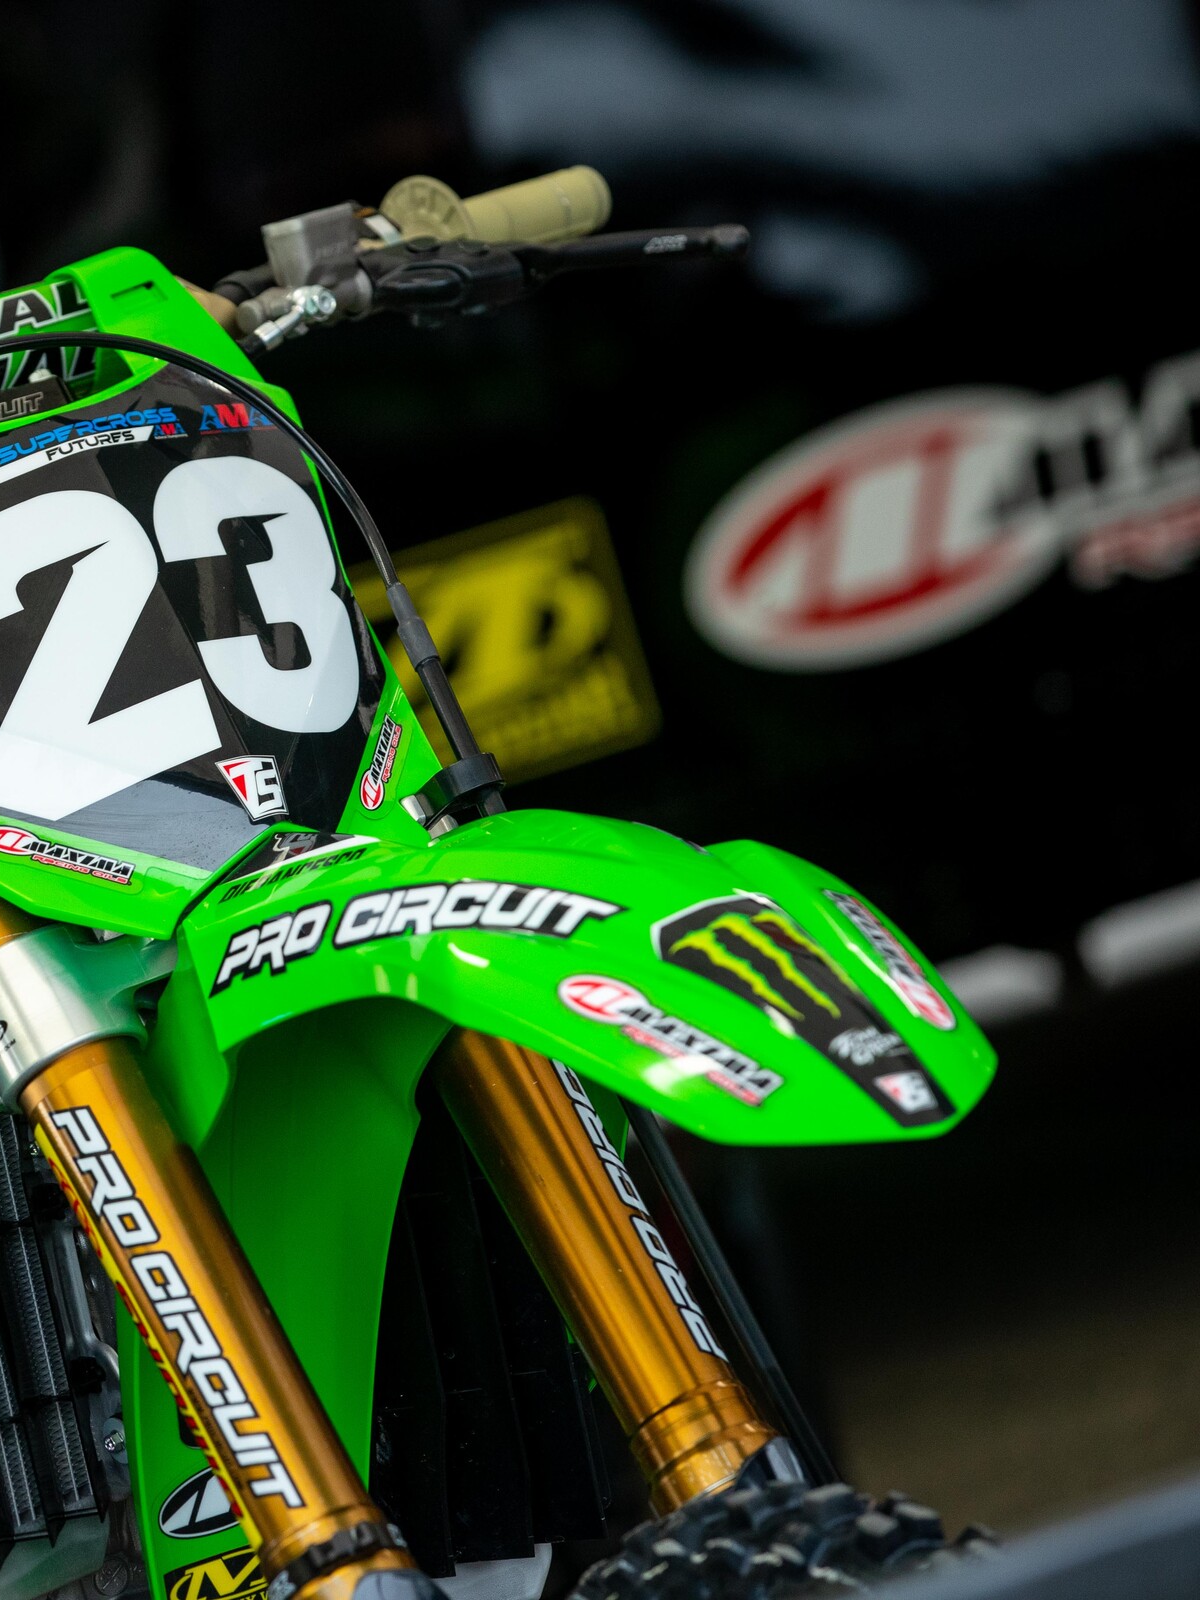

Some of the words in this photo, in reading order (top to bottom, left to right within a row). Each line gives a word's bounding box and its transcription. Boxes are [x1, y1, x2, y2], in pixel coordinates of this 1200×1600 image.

[199, 403, 274, 430] AMA
[46, 430, 136, 462] FUTURES
[22, 840, 134, 877] MAXIMA
[33, 854, 90, 874] RACING
[92, 870, 128, 884] OILS
[211, 901, 332, 992] PRO
[334, 881, 626, 948] CIRCUIT
[51, 1107, 160, 1247] PRO
[132, 1251, 305, 1508] CIRCUIT
